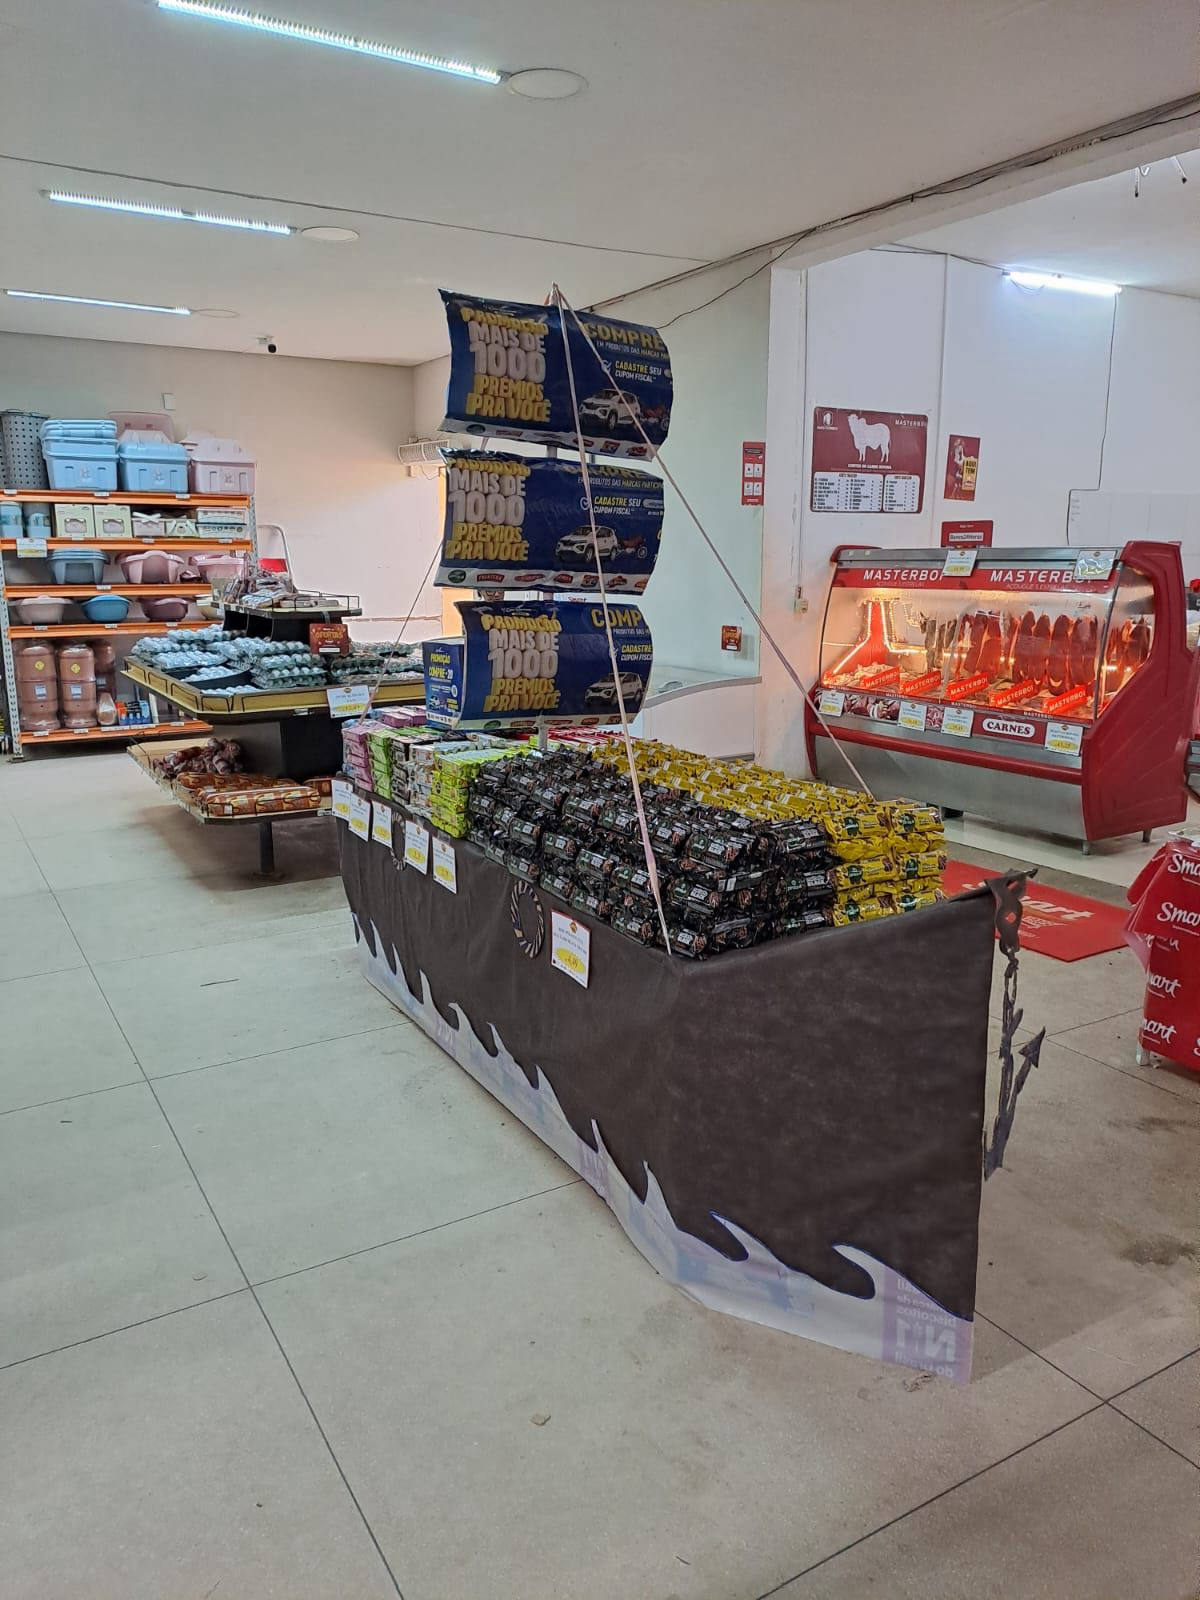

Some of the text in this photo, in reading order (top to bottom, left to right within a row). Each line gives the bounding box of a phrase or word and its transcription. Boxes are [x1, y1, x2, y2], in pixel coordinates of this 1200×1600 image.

[468, 320, 546, 353] MAIS DE
[470, 343, 547, 384] 1000
[615, 360, 662, 376] CADASTRE SEU
[466, 392, 506, 418] PRA
[449, 467, 527, 497] MAIS DE
[449, 490, 525, 526] 1000
[594, 496, 628, 507] CADASTRE
[628, 498, 642, 508] SEU
[446, 540, 491, 561] PRA
[488, 628, 560, 651] MAIS DE
[488, 648, 558, 680] 1000
[483, 694, 524, 713] PRA
[987, 721, 1031, 736] CARNES
